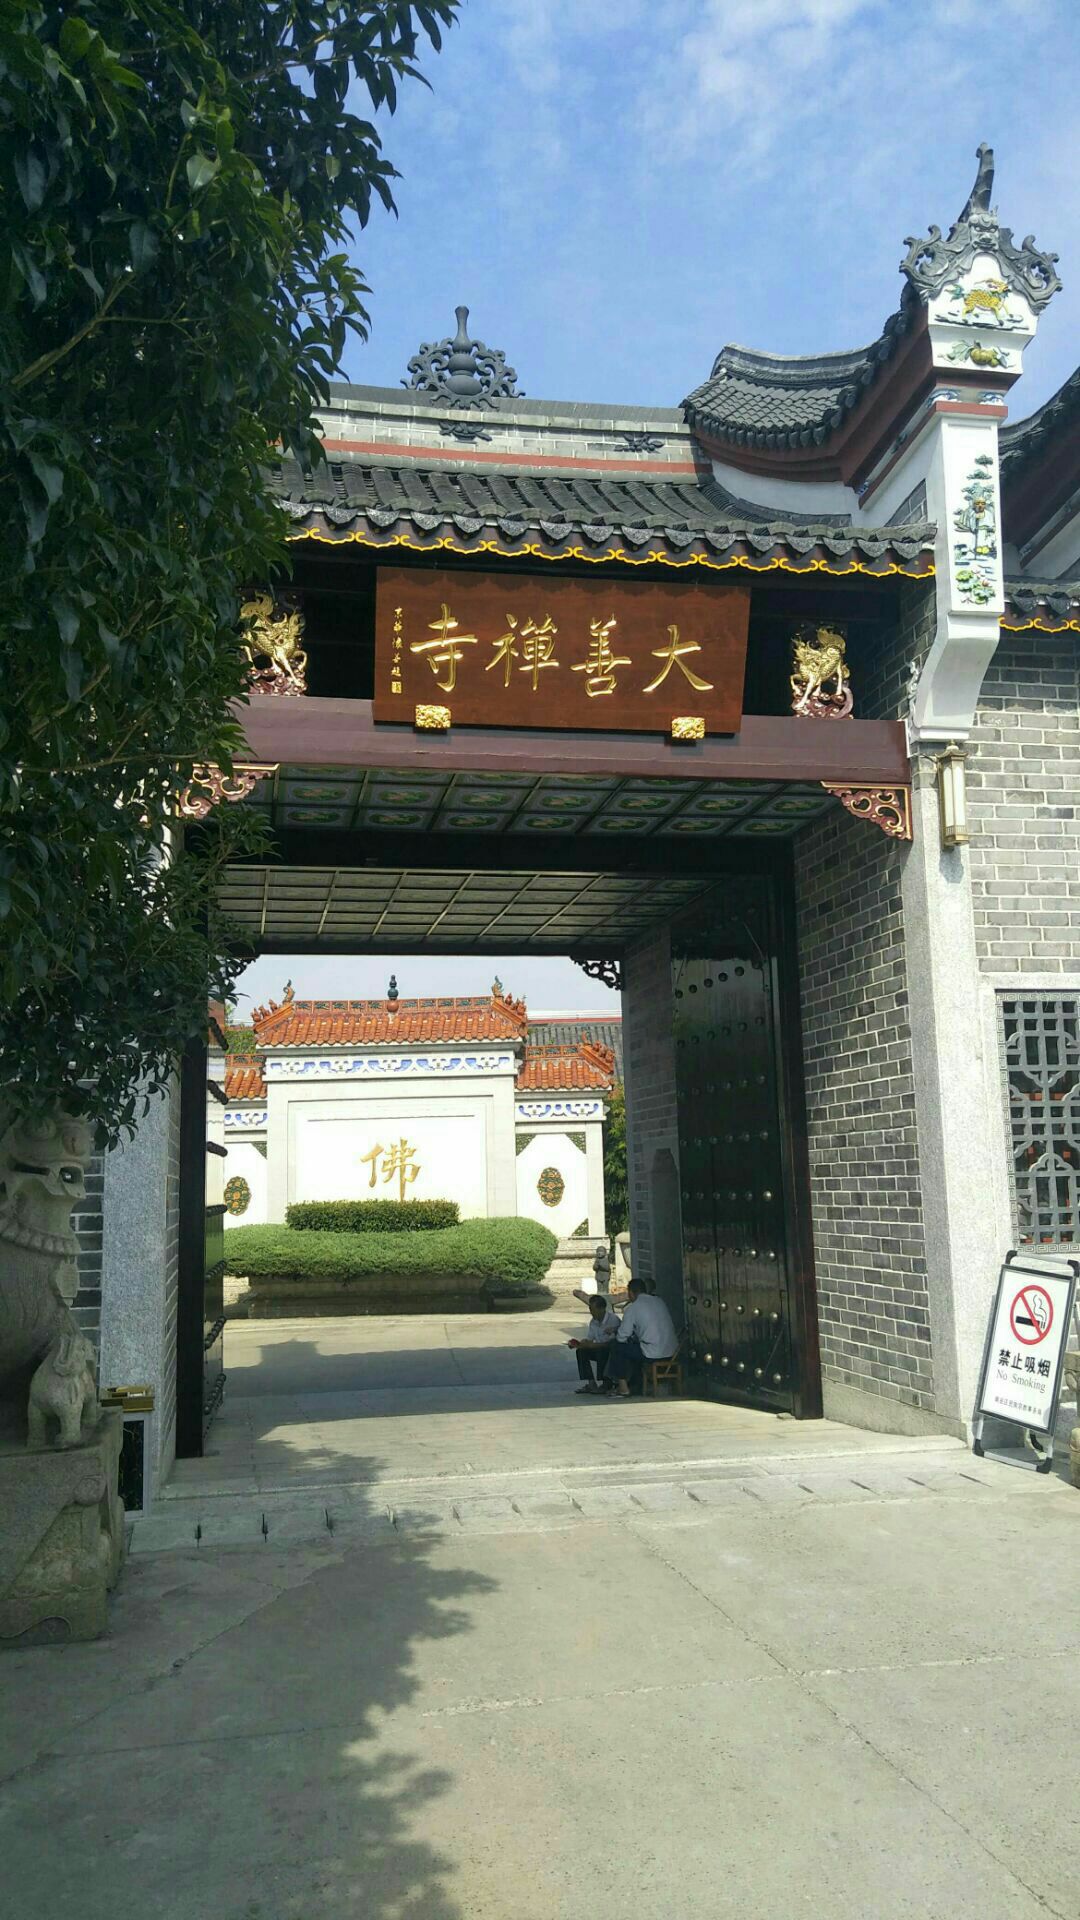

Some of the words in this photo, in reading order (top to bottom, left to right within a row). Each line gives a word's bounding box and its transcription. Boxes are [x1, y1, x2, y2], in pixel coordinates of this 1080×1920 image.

[360, 1137, 422, 1201] 佛
[998, 1349, 1051, 1378] 禁止吸烟
[997, 1369, 1008, 1380] No
[1011, 1373, 1046, 1393] Smoking
